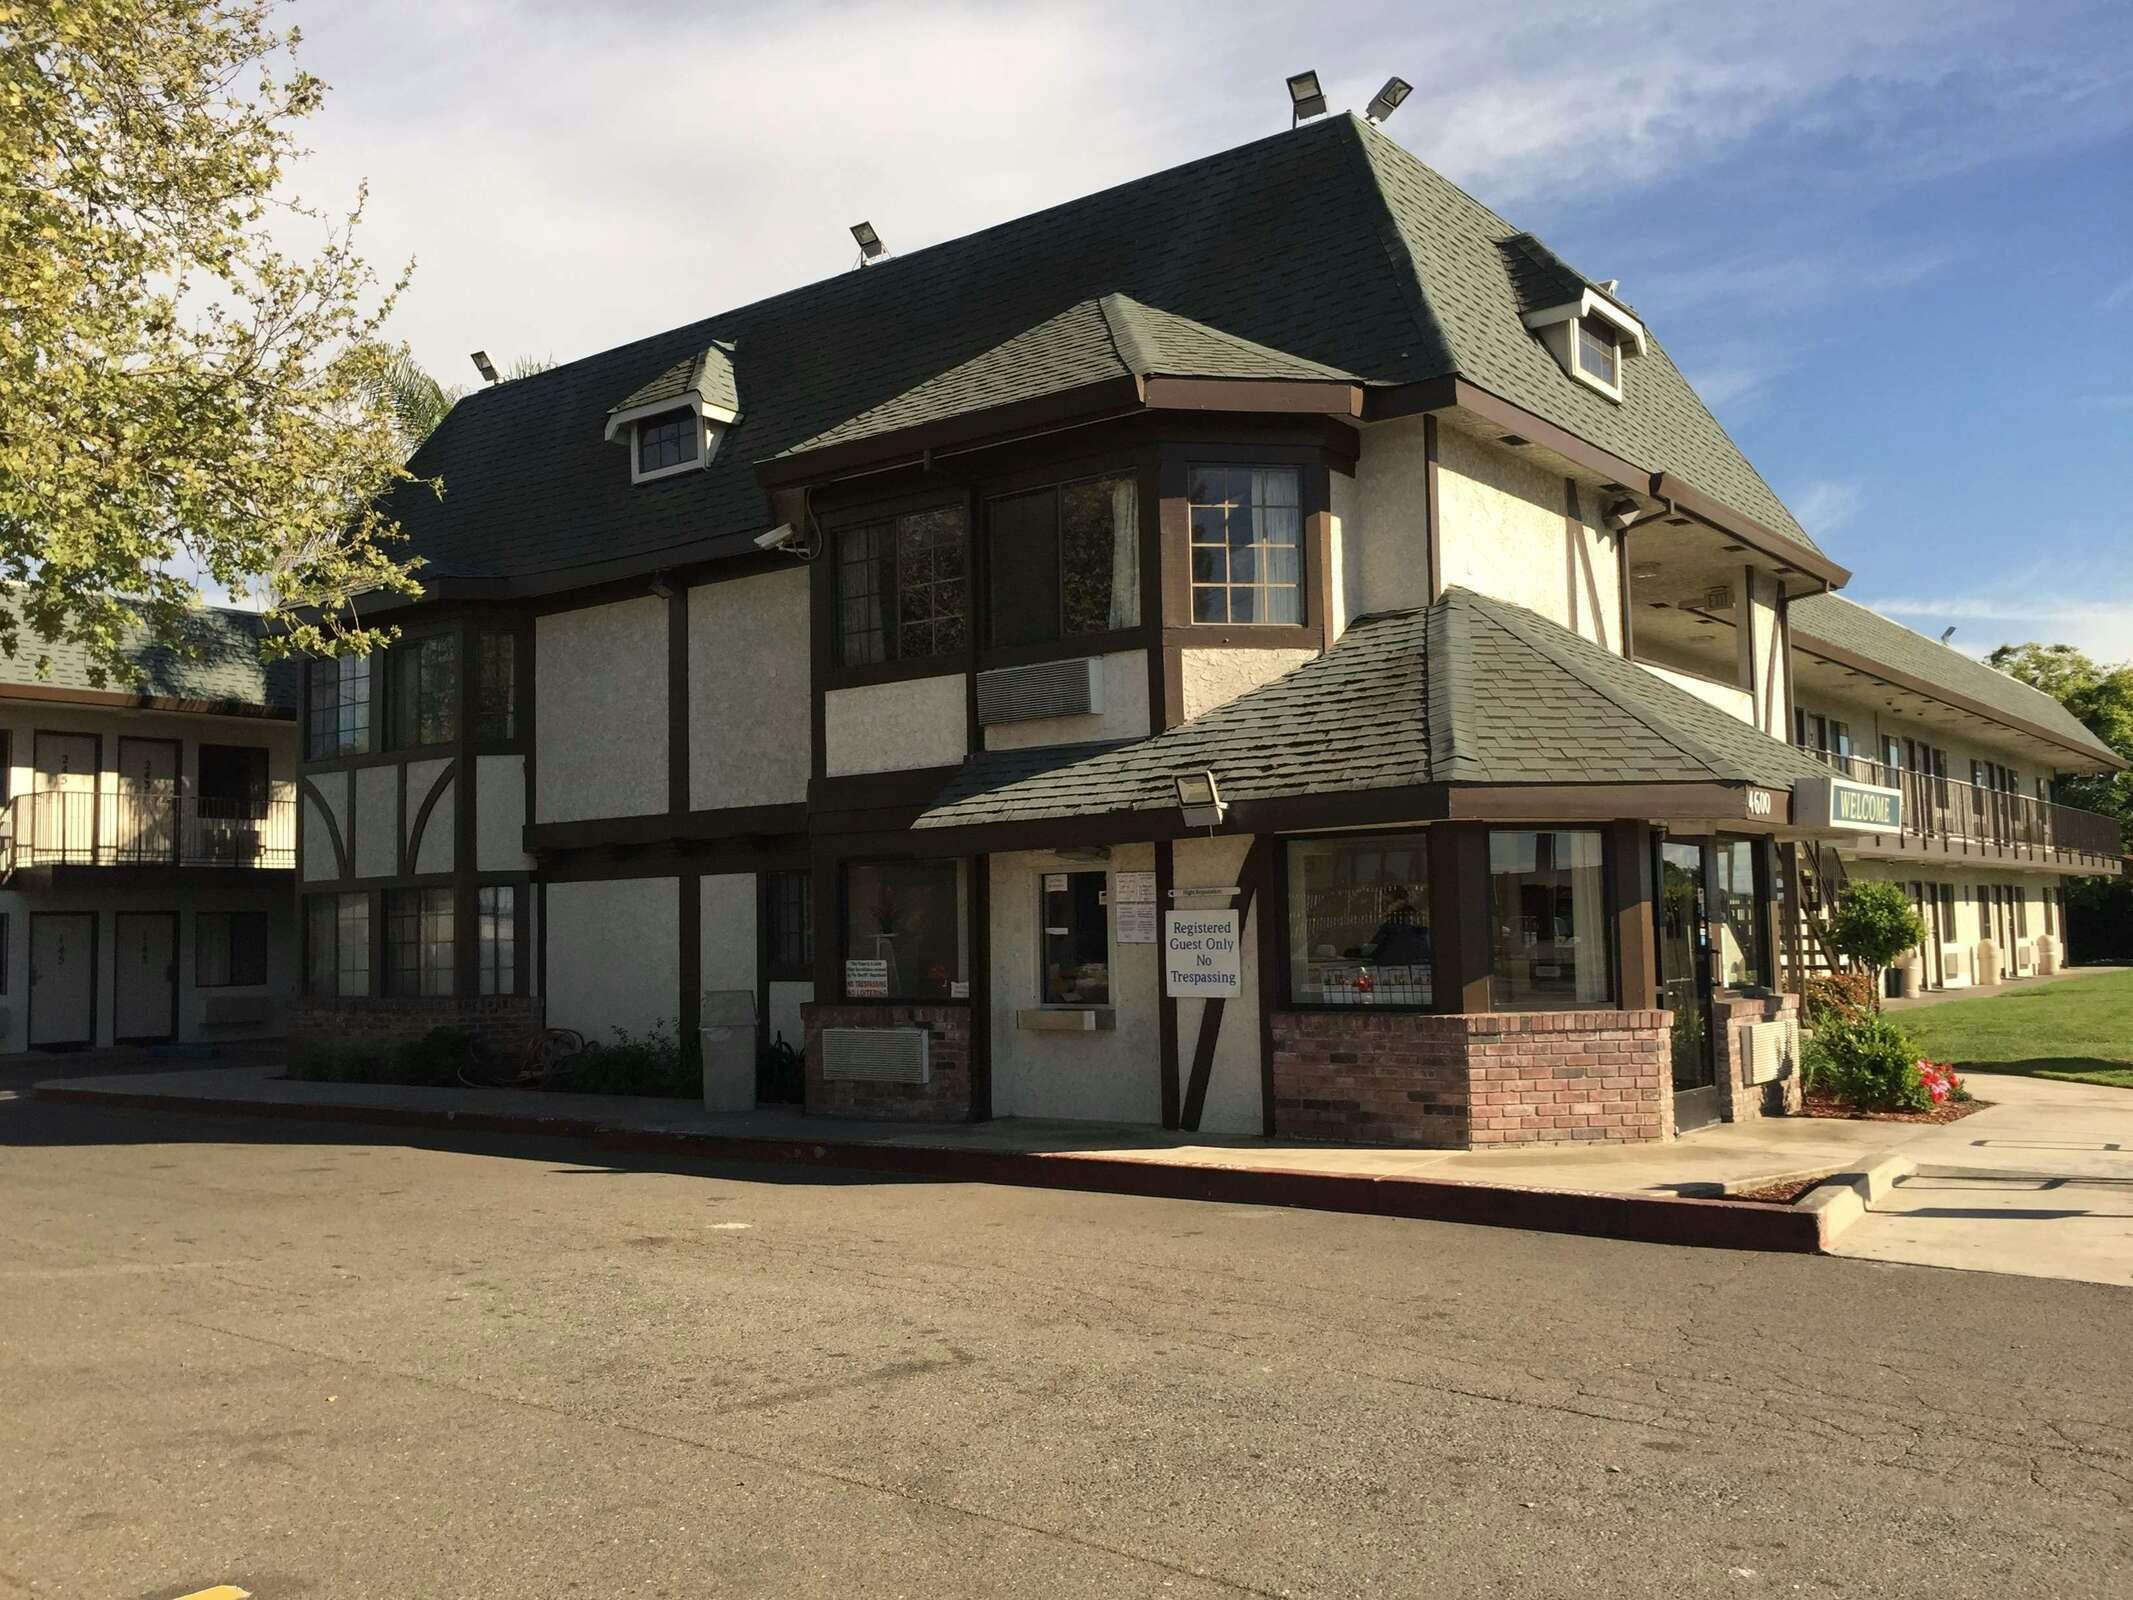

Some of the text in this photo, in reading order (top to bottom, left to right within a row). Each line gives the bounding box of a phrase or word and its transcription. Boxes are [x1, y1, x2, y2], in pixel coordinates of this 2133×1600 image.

[1747, 790, 1771, 815] 4600
[1840, 790, 1891, 823] WELCOME
[1173, 921, 1231, 937] Registered
[1169, 937, 1234, 953] Guest Only
[1196, 953, 1213, 967] No
[1170, 970, 1237, 986] Trespassing
